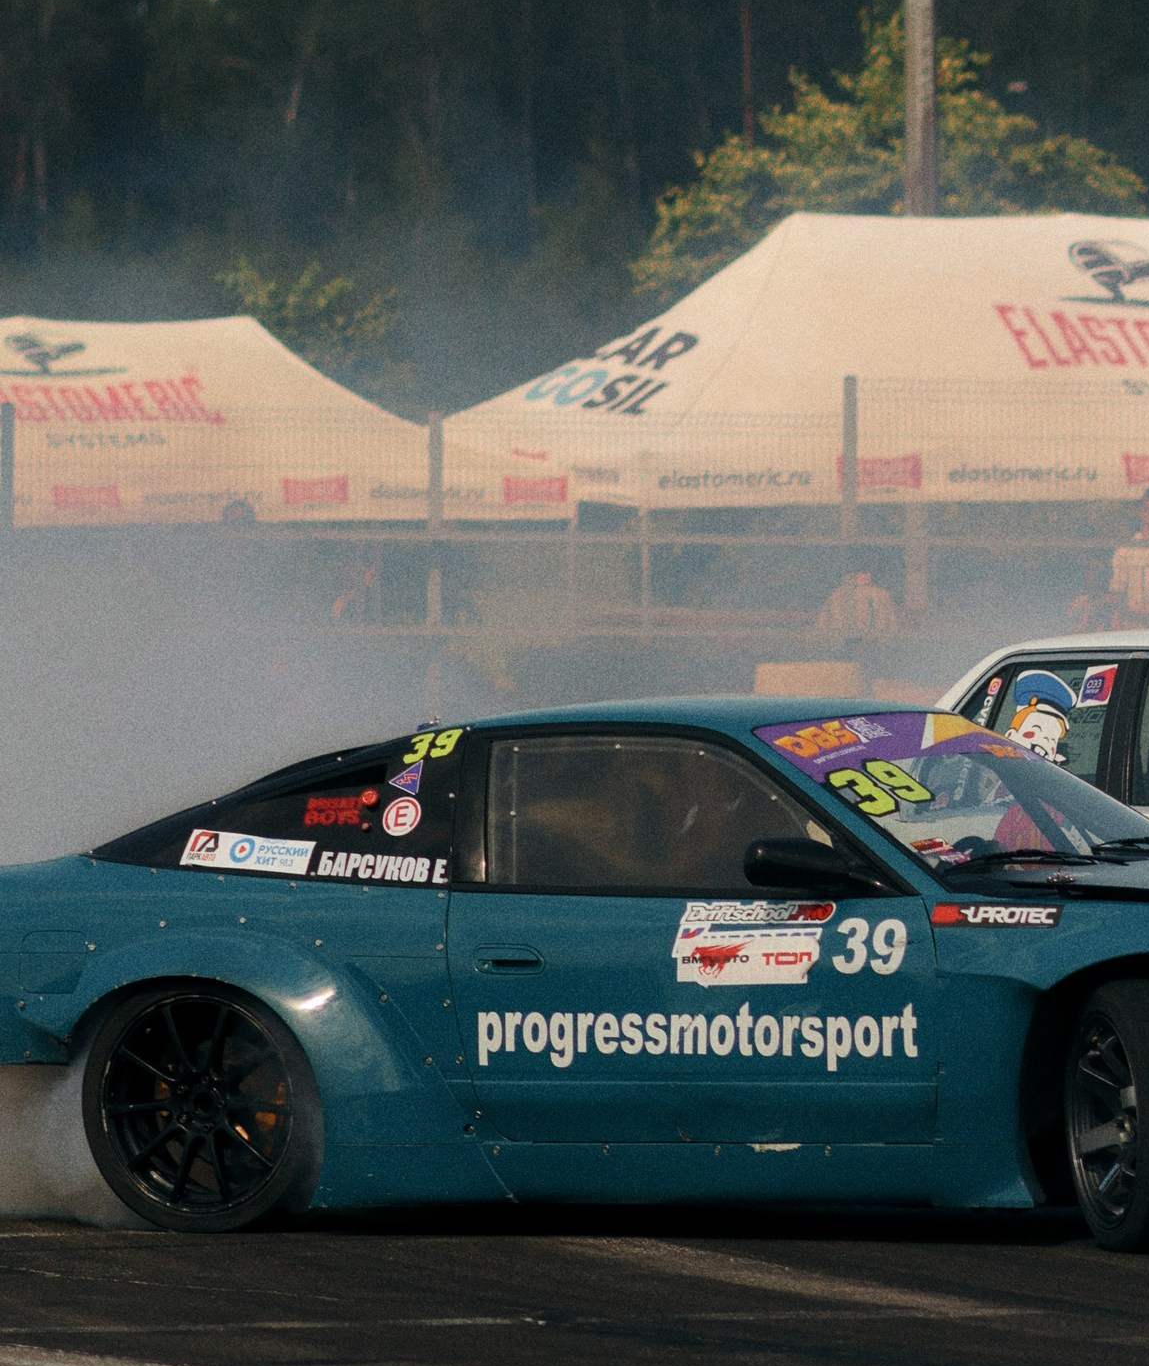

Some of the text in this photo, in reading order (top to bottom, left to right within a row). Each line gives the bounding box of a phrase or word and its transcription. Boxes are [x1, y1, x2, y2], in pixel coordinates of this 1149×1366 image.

[658, 467, 812, 489] elastomeric.ru
[947, 463, 1098, 484] elastomeric.ru
[403, 729, 463, 765] 39
[774, 719, 858, 759] DBS
[827, 759, 935, 817] 39
[254, 857, 277, 867] ХИТ
[317, 851, 430, 882] БАРСУКОВ
[832, 918, 907, 976] 39
[477, 1001, 918, 1072] progressmotorsport
